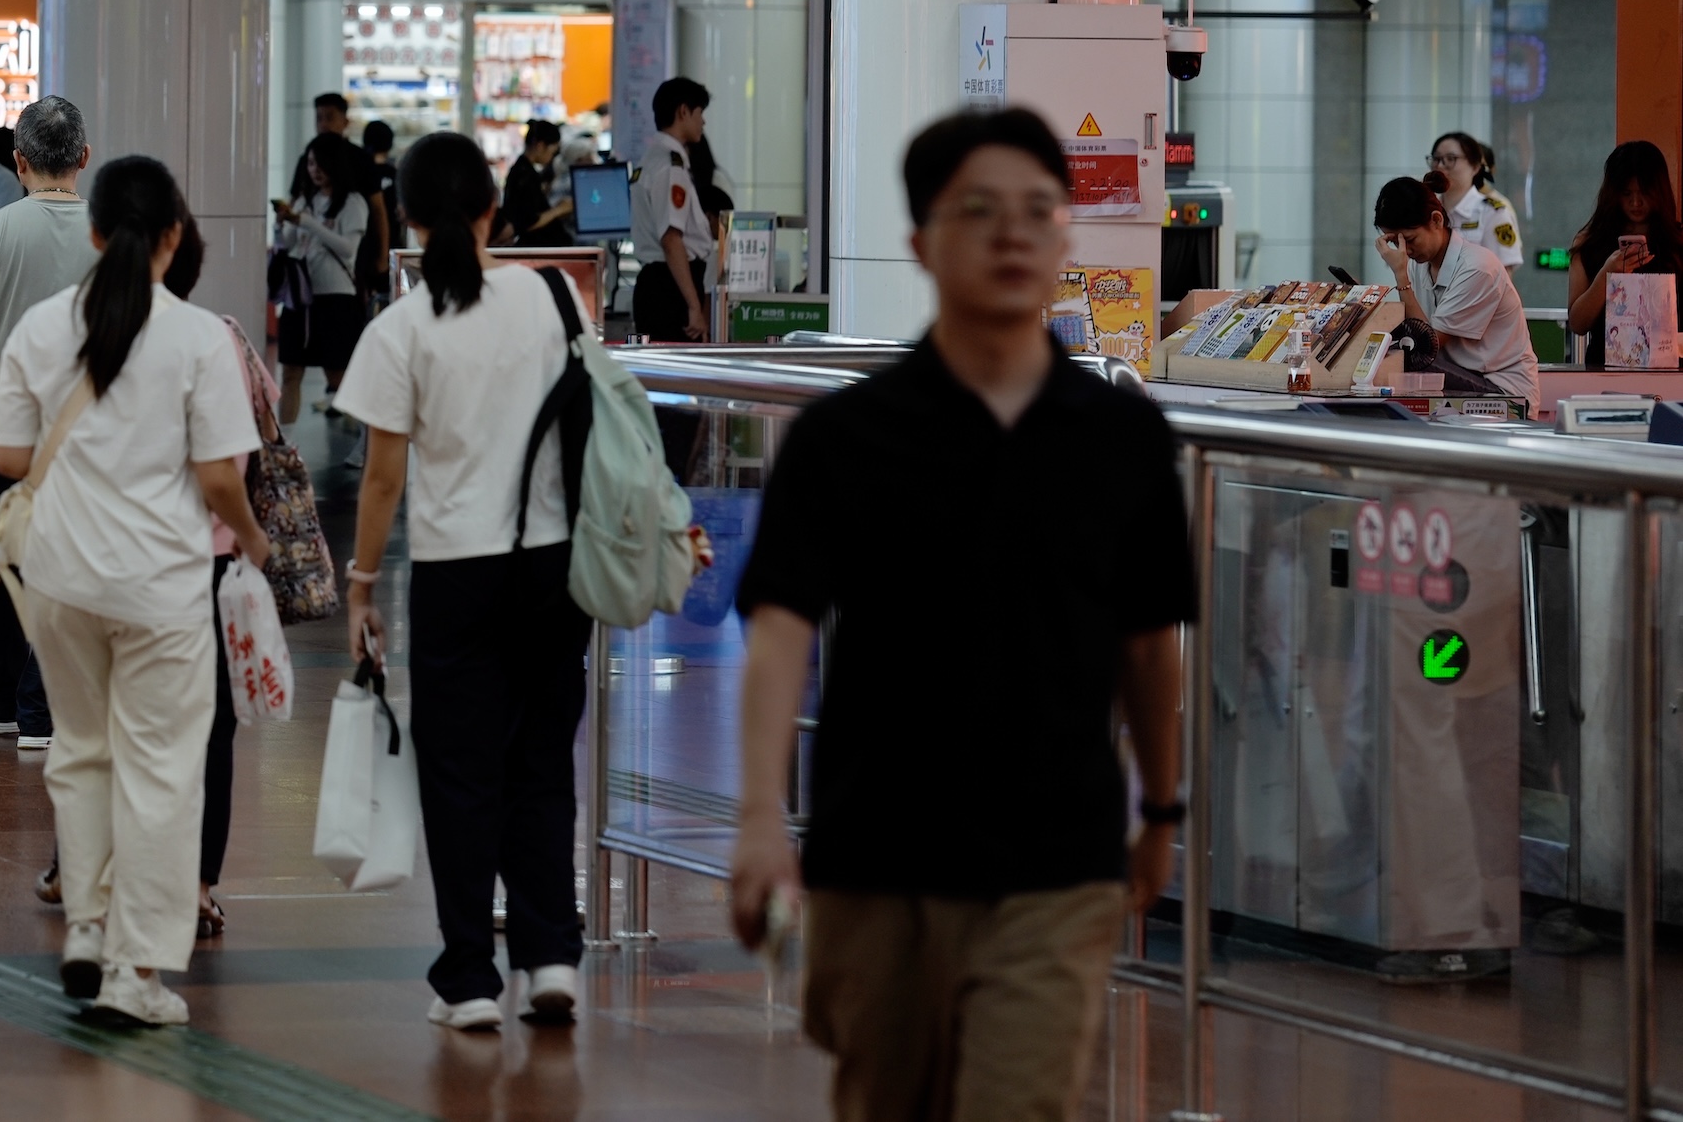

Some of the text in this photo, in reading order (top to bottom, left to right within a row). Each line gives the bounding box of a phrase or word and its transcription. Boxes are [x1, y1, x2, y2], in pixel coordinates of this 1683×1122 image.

[964, 78, 1004, 95] 中国体育彩票
[1068, 144, 1107, 152] 中国体育彩票
[1099, 336, 1141, 358] 100万
